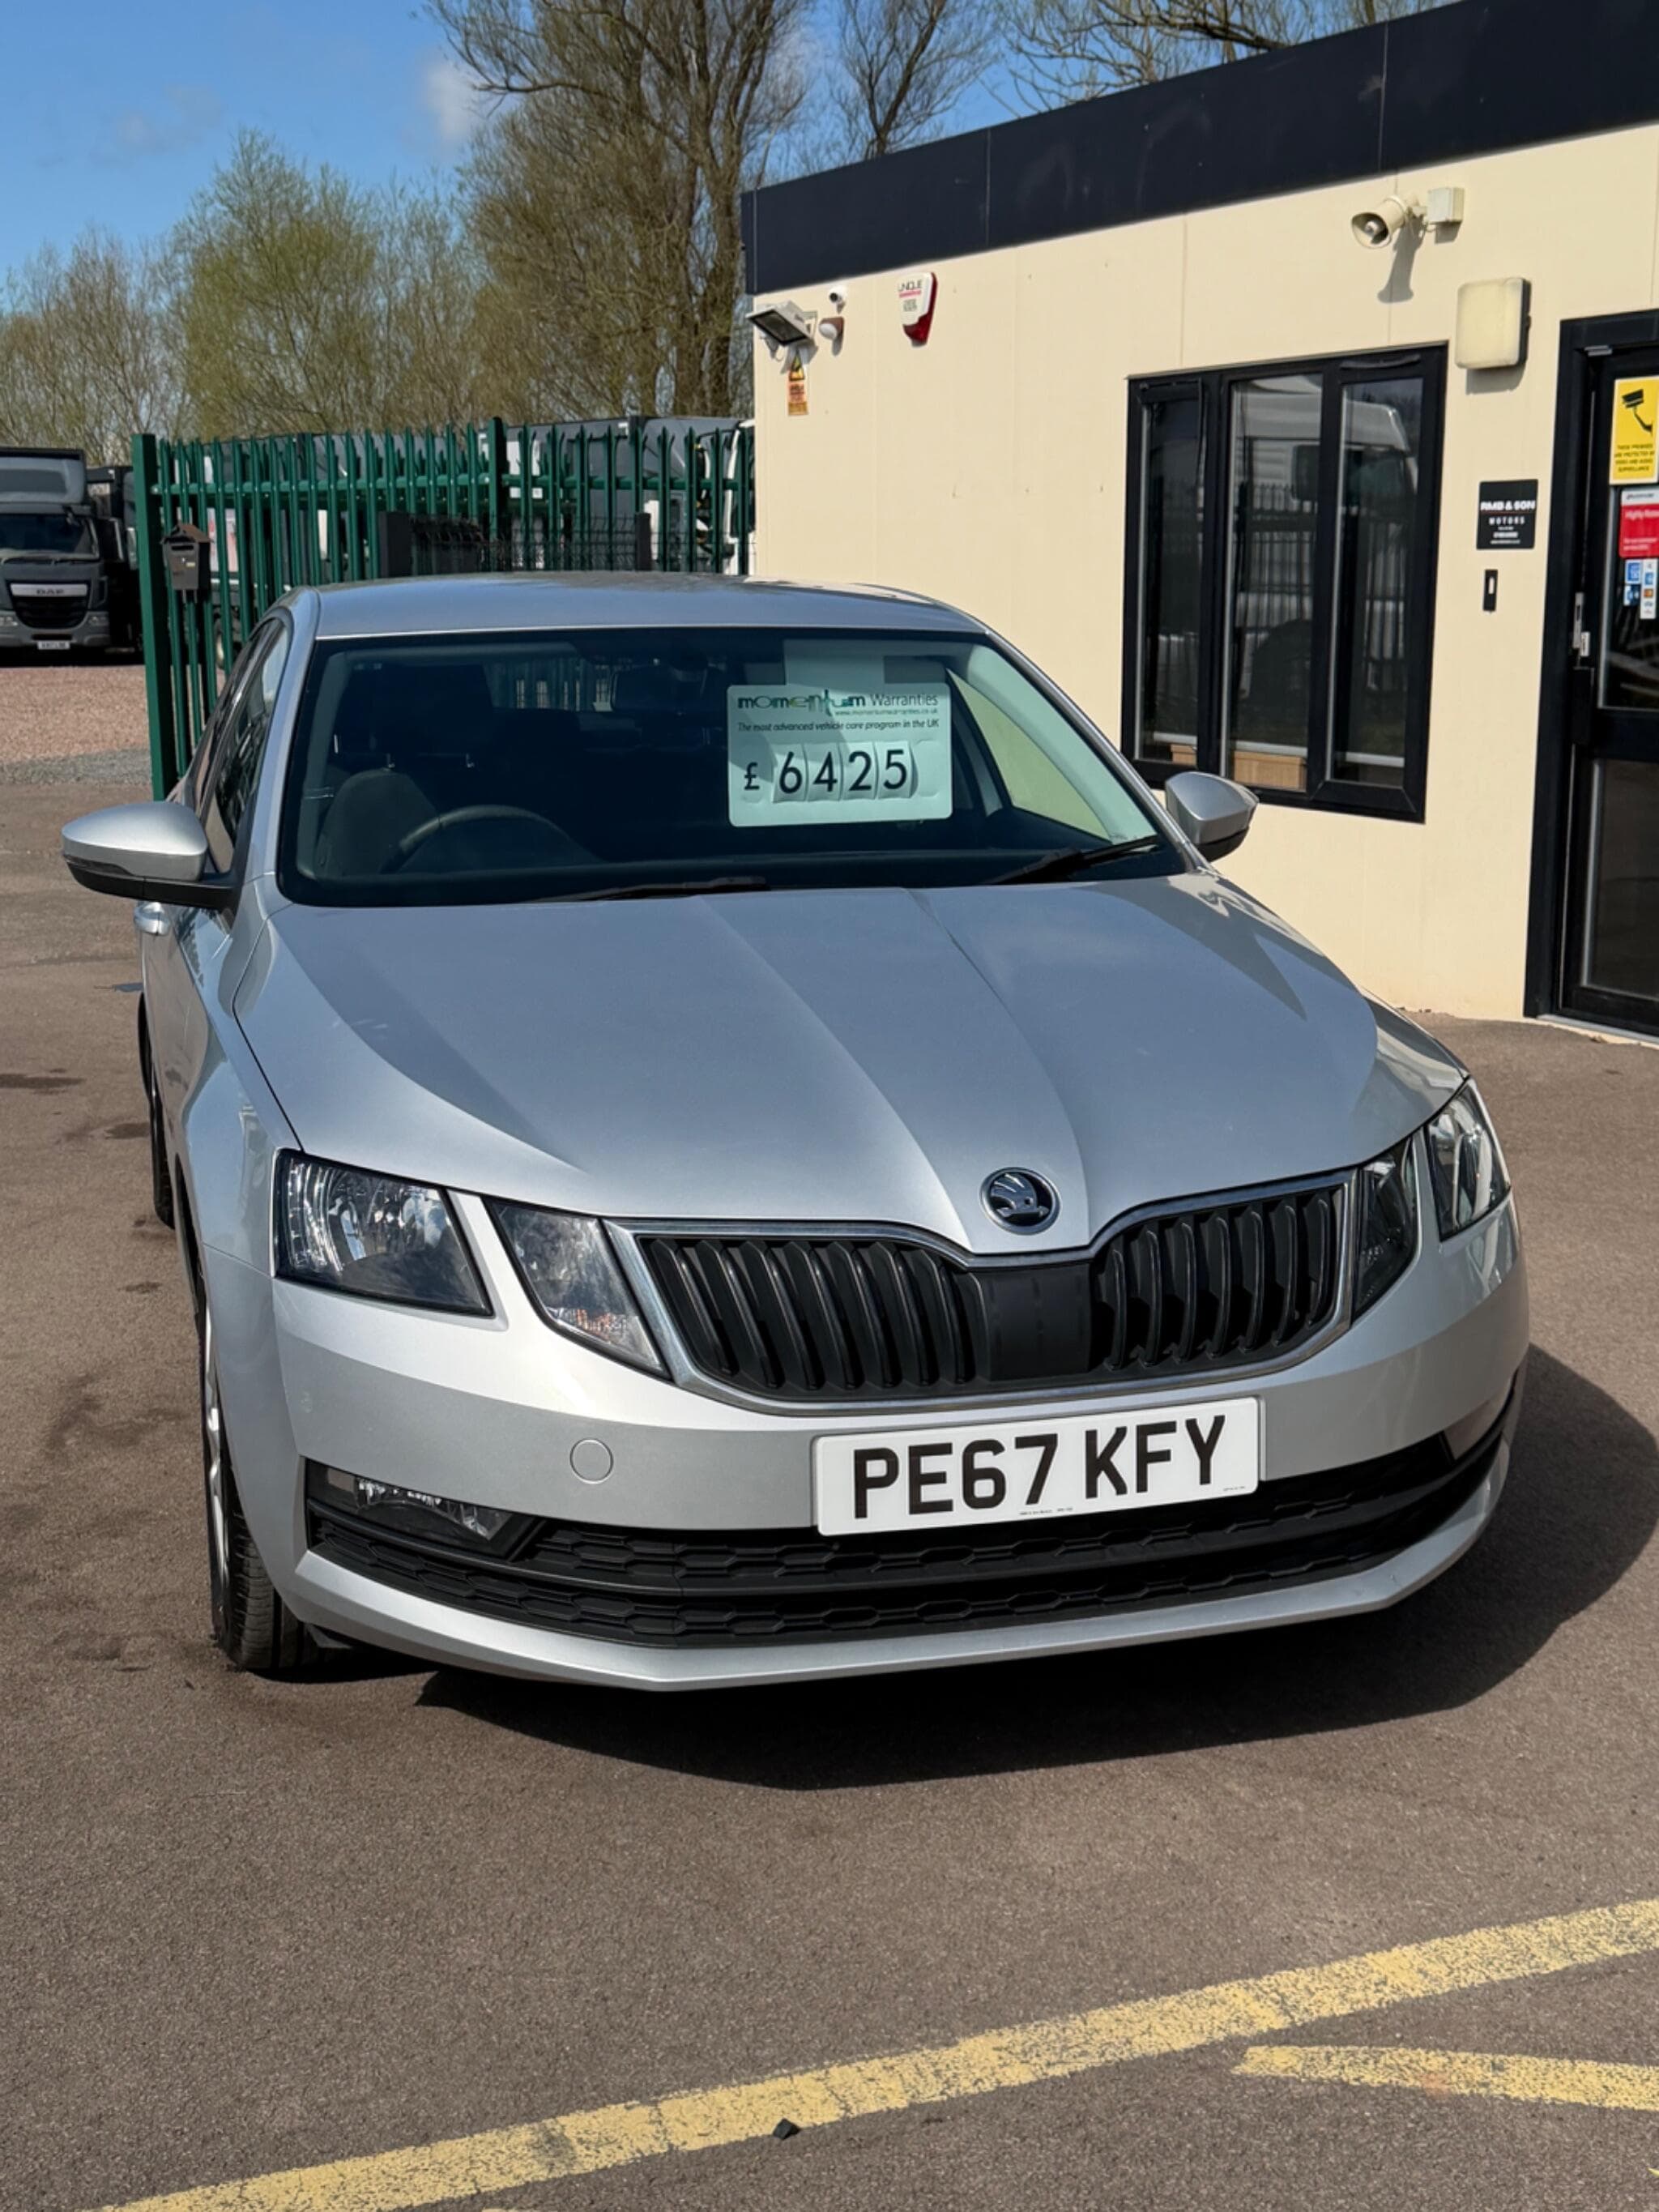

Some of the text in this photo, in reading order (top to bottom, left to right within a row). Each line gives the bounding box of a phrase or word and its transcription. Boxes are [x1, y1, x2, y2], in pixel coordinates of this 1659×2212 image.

[1514, 500, 1536, 510] SON
[1489, 516, 1525, 525] MOTORS
[737, 689, 939, 717] momentum Warranties
[738, 722, 752, 731] The
[753, 723, 772, 731] most
[773, 722, 813, 731] advanced
[815, 721, 843, 731] vehicle
[864, 722, 902, 732] program
[903, 720, 911, 728] in
[912, 719, 925, 728] the
[927, 718, 940, 728] UK
[744, 749, 907, 794] £ 6425
[853, 1415, 1226, 1519] PE67 KFY
